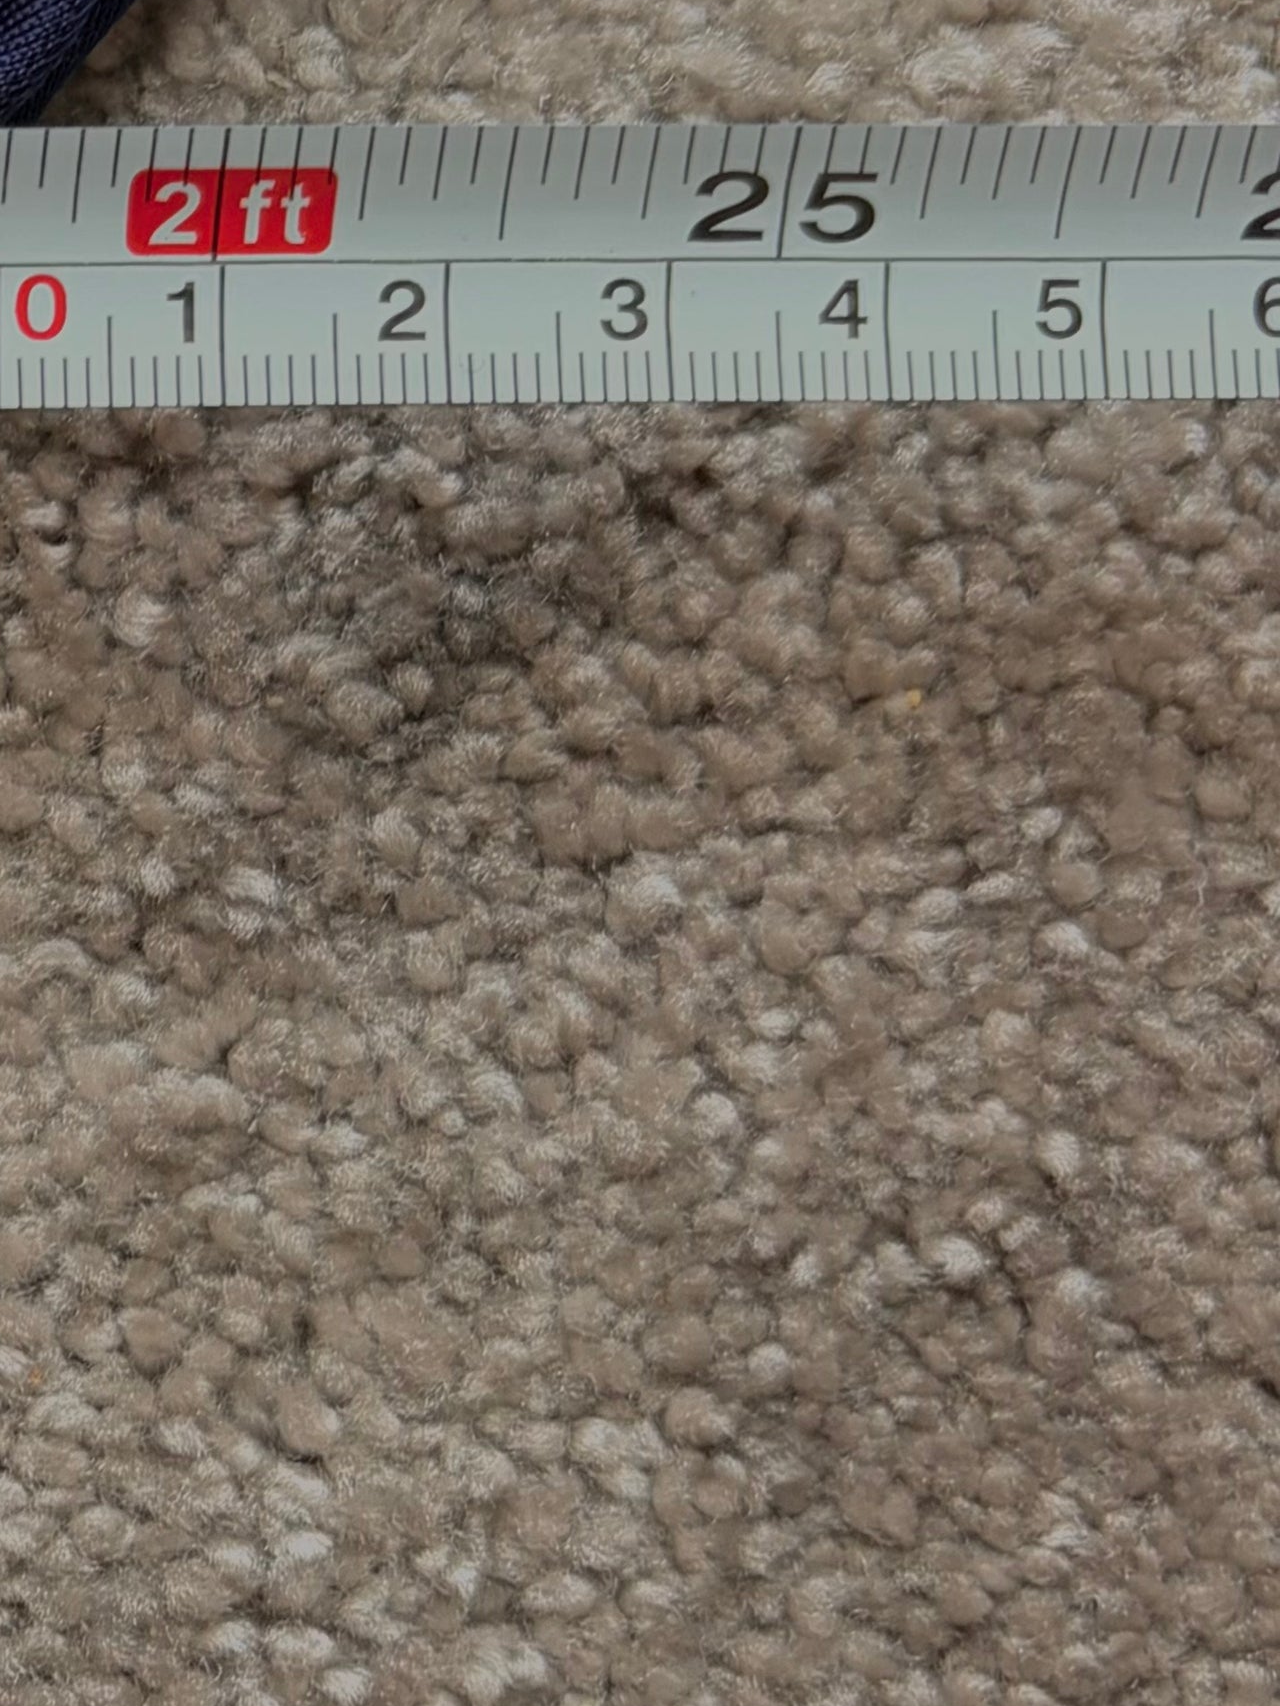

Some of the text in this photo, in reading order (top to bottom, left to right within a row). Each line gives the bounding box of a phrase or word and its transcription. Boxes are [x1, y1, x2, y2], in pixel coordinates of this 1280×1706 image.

[148, 181, 203, 245] 2
[240, 181, 310, 245] ft
[687, 171, 880, 243] 25
[166, 281, 197, 343] 1
[377, 281, 427, 341] 2
[600, 279, 648, 340] 3
[818, 280, 868, 339] 4
[1035, 279, 1084, 339] 5
